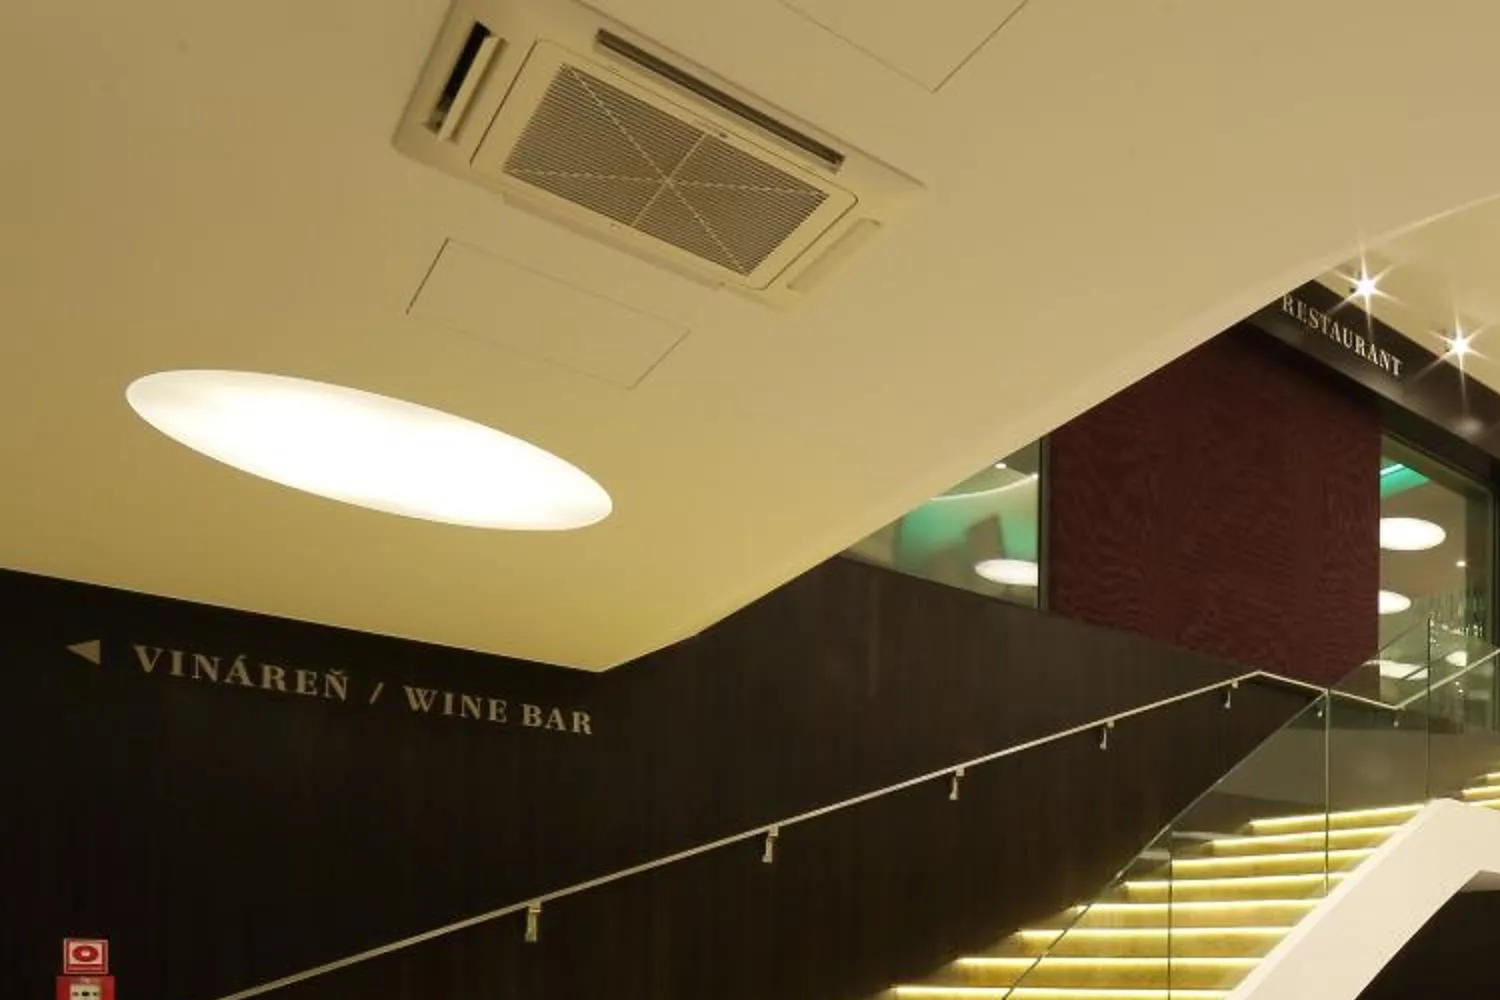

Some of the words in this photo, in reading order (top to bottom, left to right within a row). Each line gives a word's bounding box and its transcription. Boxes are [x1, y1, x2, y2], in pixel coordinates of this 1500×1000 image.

[1282, 293, 1402, 377] RESTAURANT
[133, 643, 348, 700] VINÁREŇ
[402, 685, 508, 723] WINE
[522, 703, 593, 735] BAR
